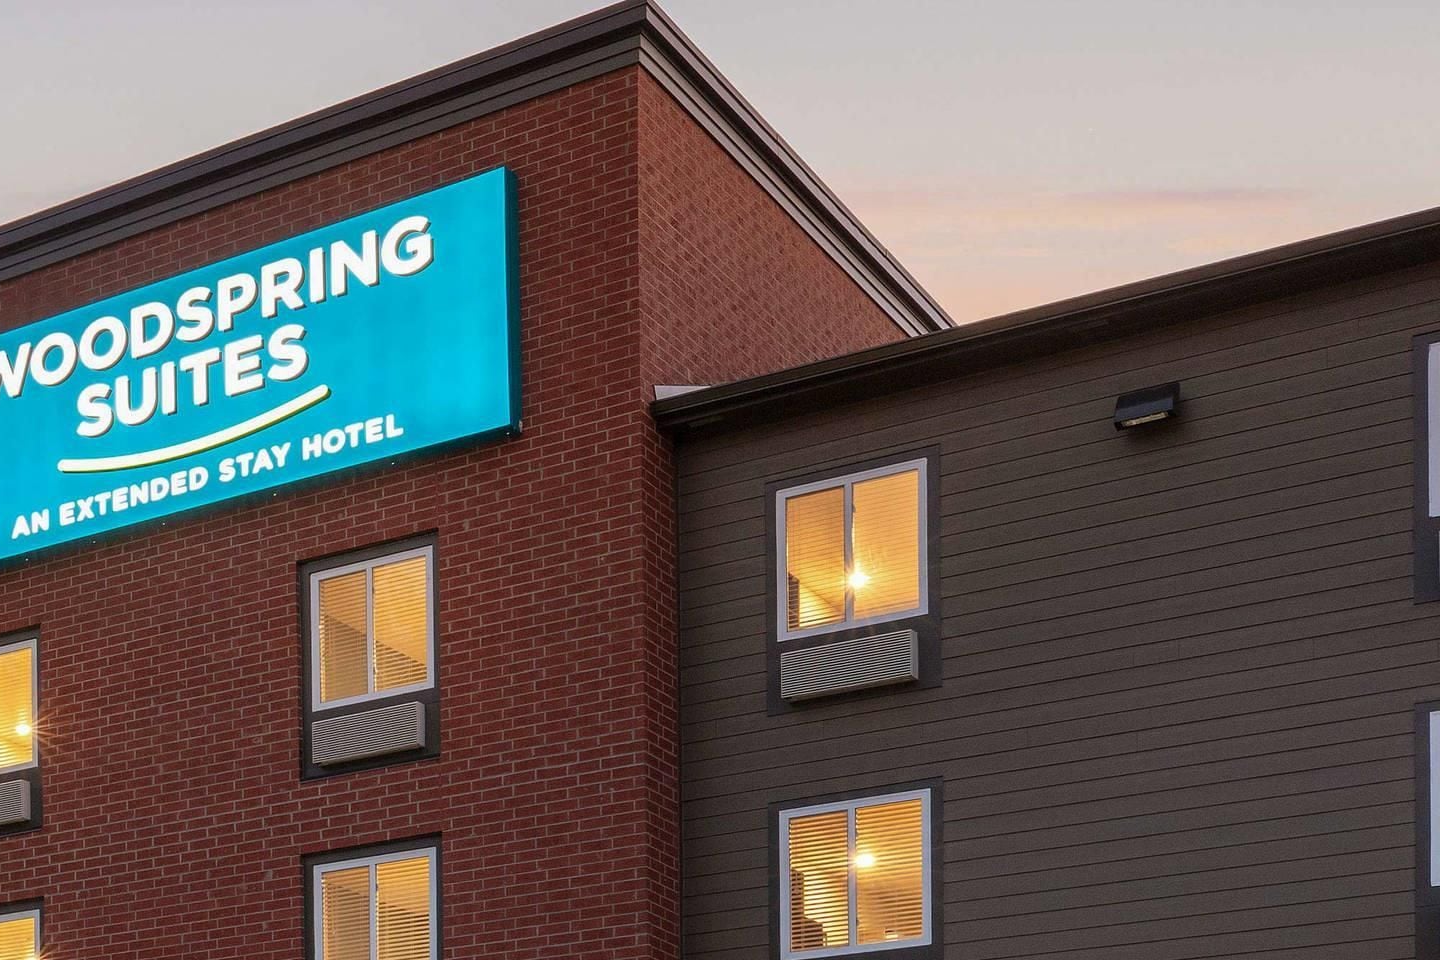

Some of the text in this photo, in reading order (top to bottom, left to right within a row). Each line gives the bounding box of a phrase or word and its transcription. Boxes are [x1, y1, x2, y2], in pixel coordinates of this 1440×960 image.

[76, 324, 308, 438] SUITES
[11, 414, 404, 540] AN EXTENDED STAY HOTEL
